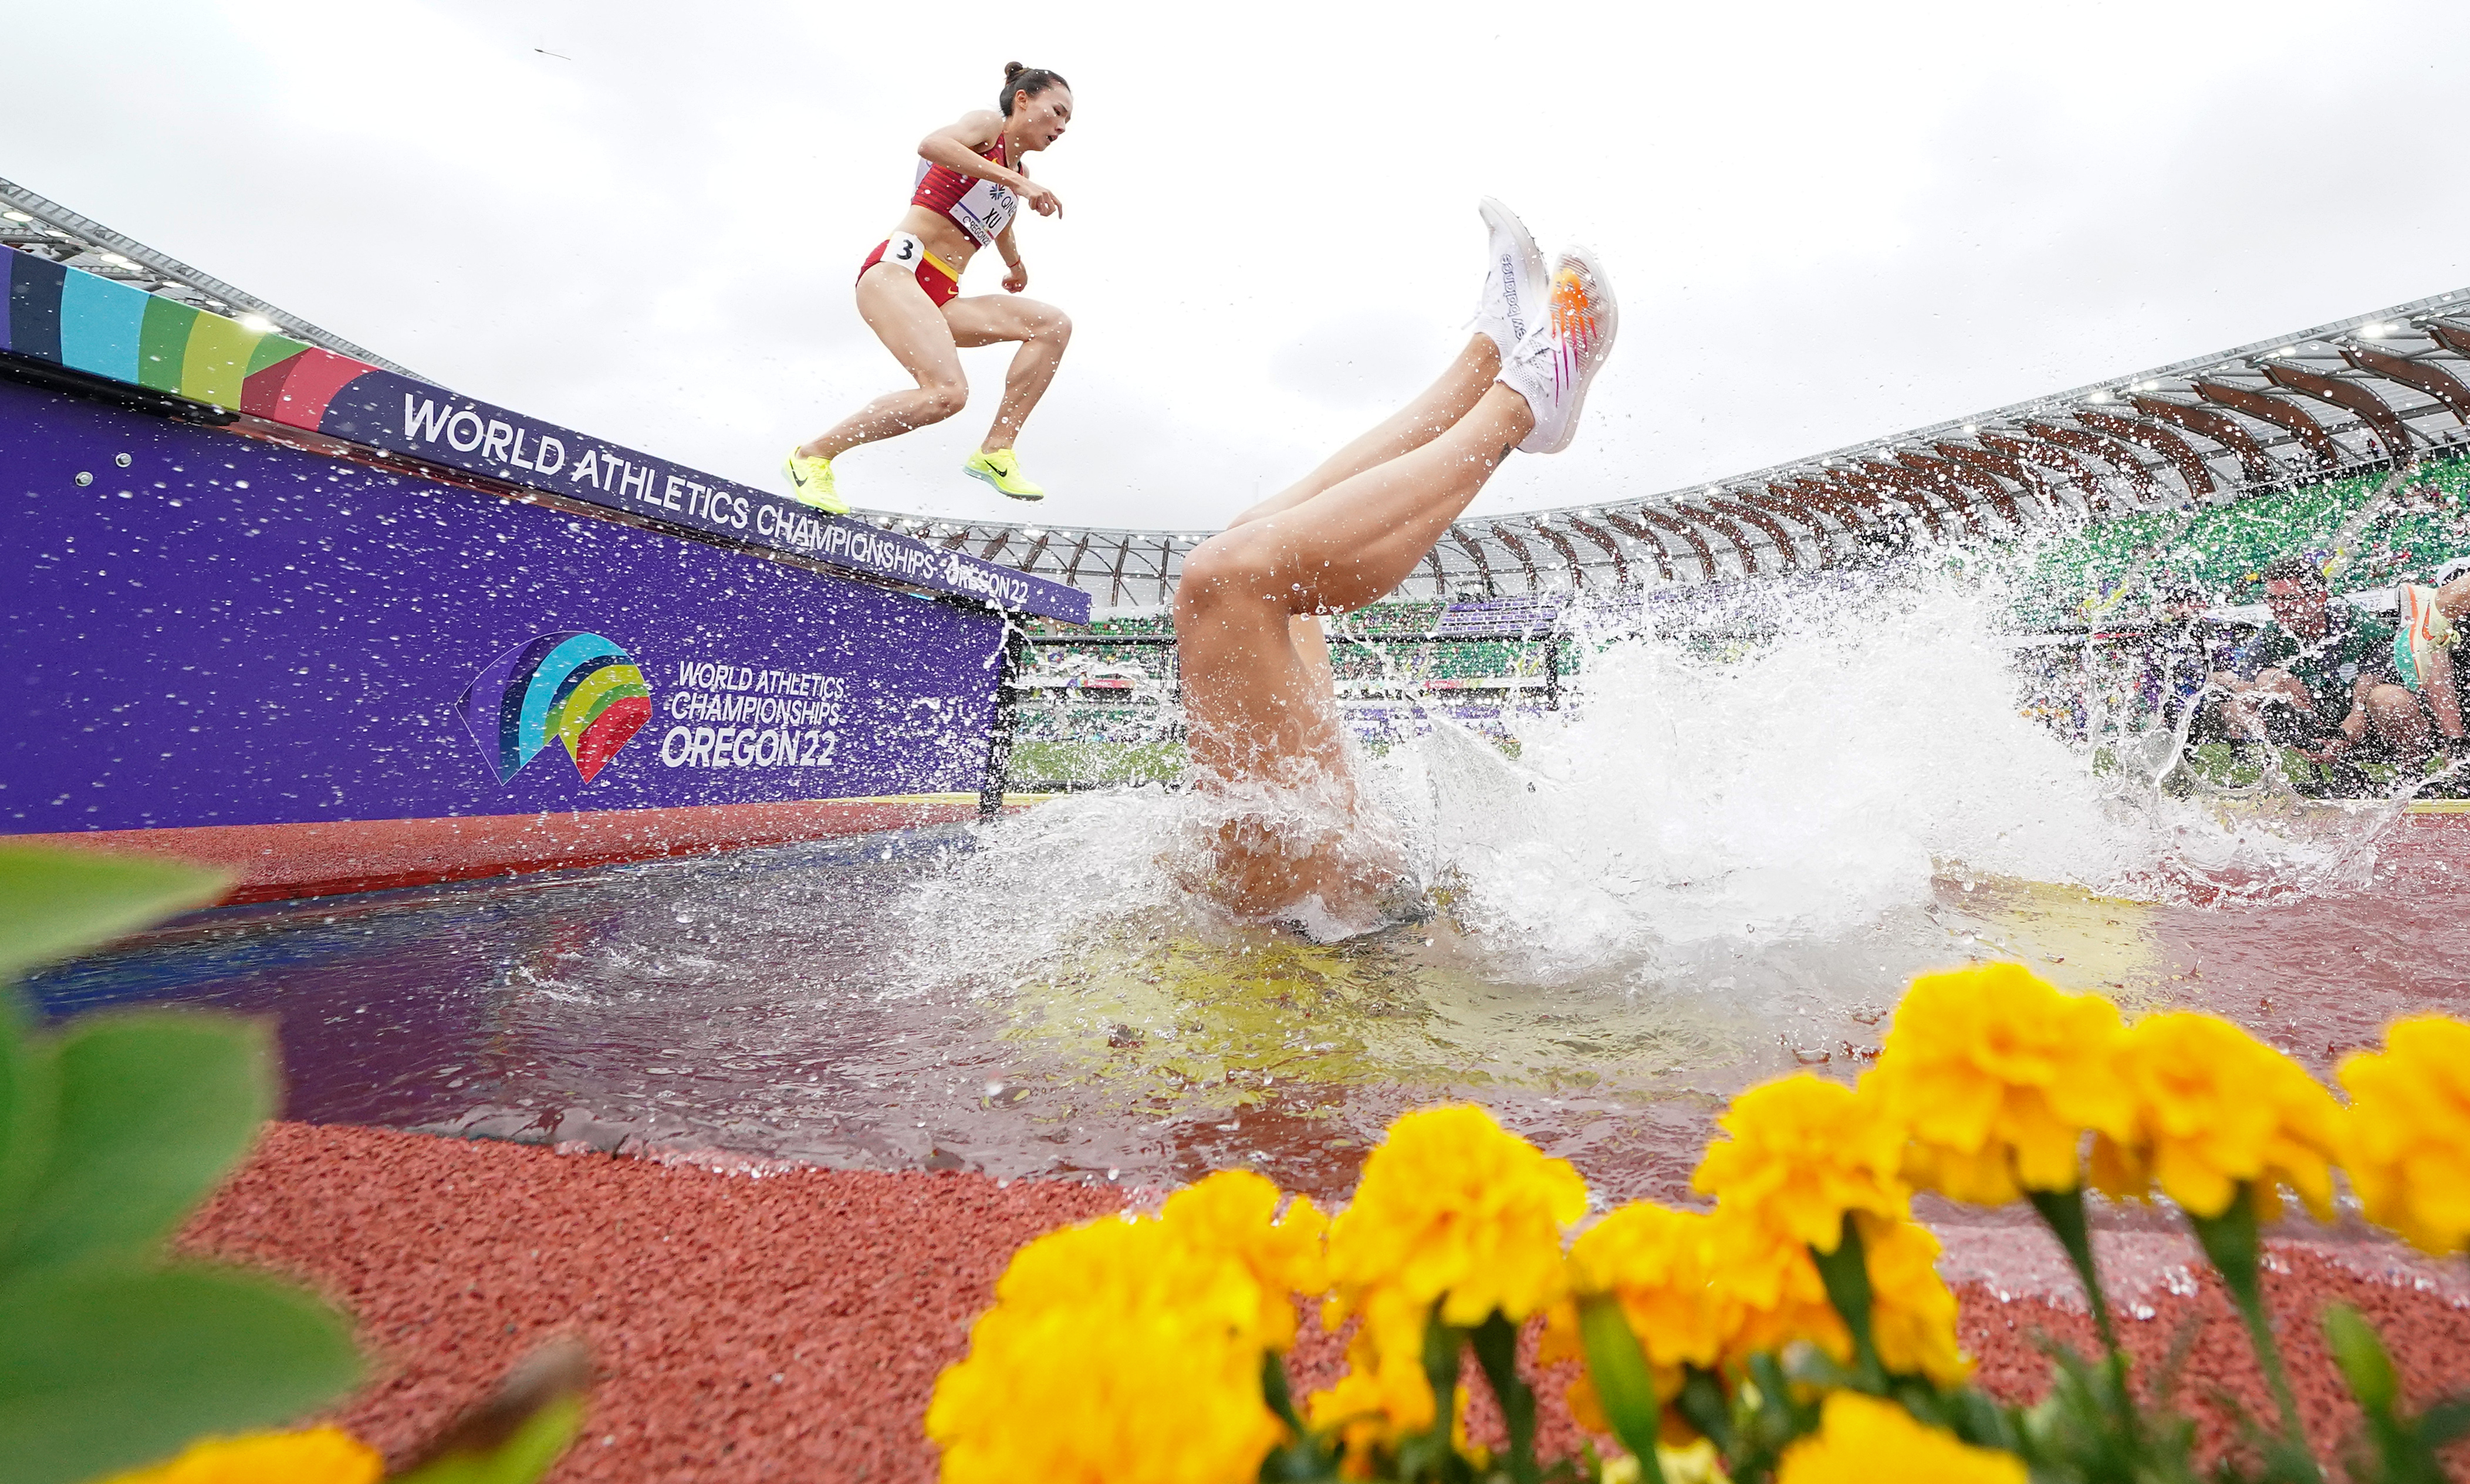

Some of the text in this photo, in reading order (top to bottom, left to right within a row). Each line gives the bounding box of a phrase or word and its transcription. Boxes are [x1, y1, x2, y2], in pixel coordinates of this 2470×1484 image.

[982, 208, 1002, 228] XU
[897, 239, 913, 260] 3
[1501, 253, 1520, 317] balance
[404, 393, 1028, 604] WORLD ATHLETICS CHAMPIONSHIPS OREGON22
[679, 661, 845, 699] WORLD ATHLETICS
[671, 691, 842, 726] CHAMPIONSHIPS
[662, 725, 836, 768] OREGON22
